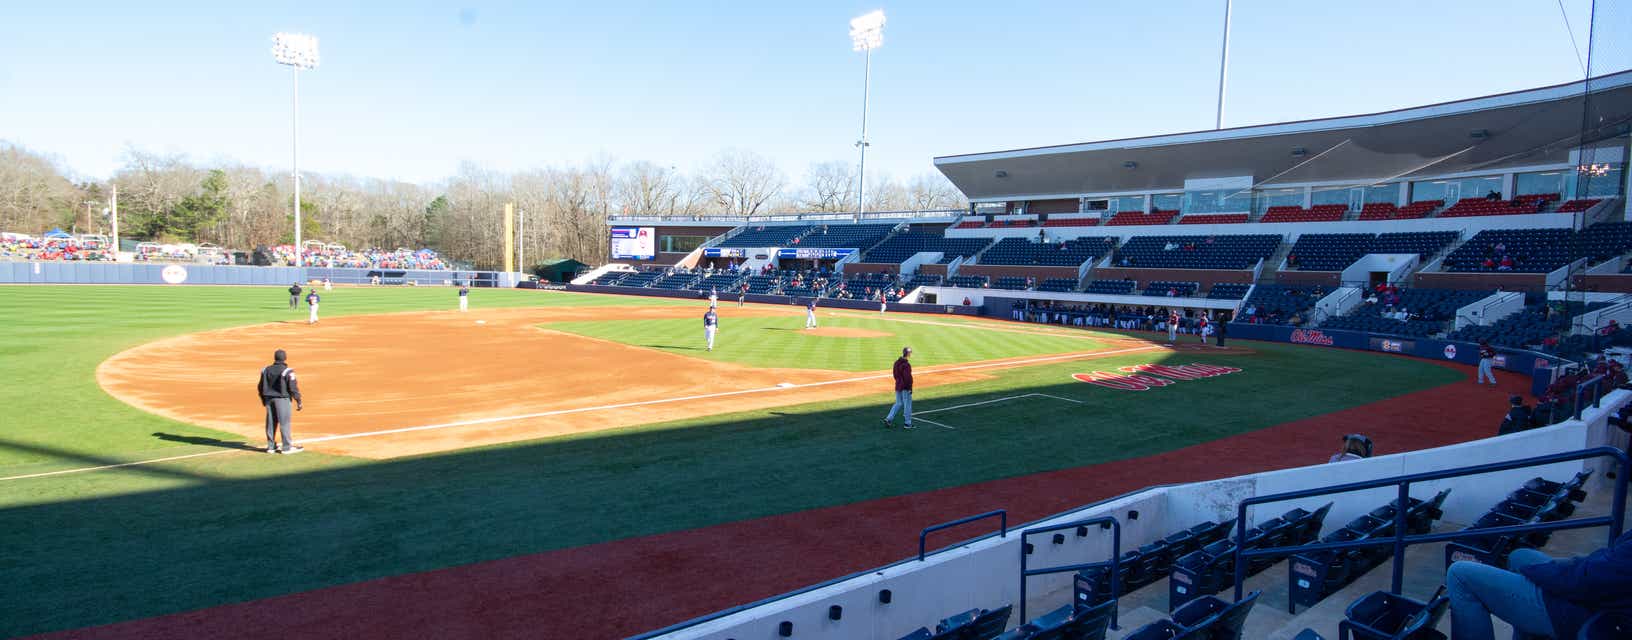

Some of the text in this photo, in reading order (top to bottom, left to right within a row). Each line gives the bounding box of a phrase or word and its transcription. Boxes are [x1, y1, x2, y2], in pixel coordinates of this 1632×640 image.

[1290, 329, 1333, 345] Ole Miss
[1072, 362, 1242, 391] Ole Miss
